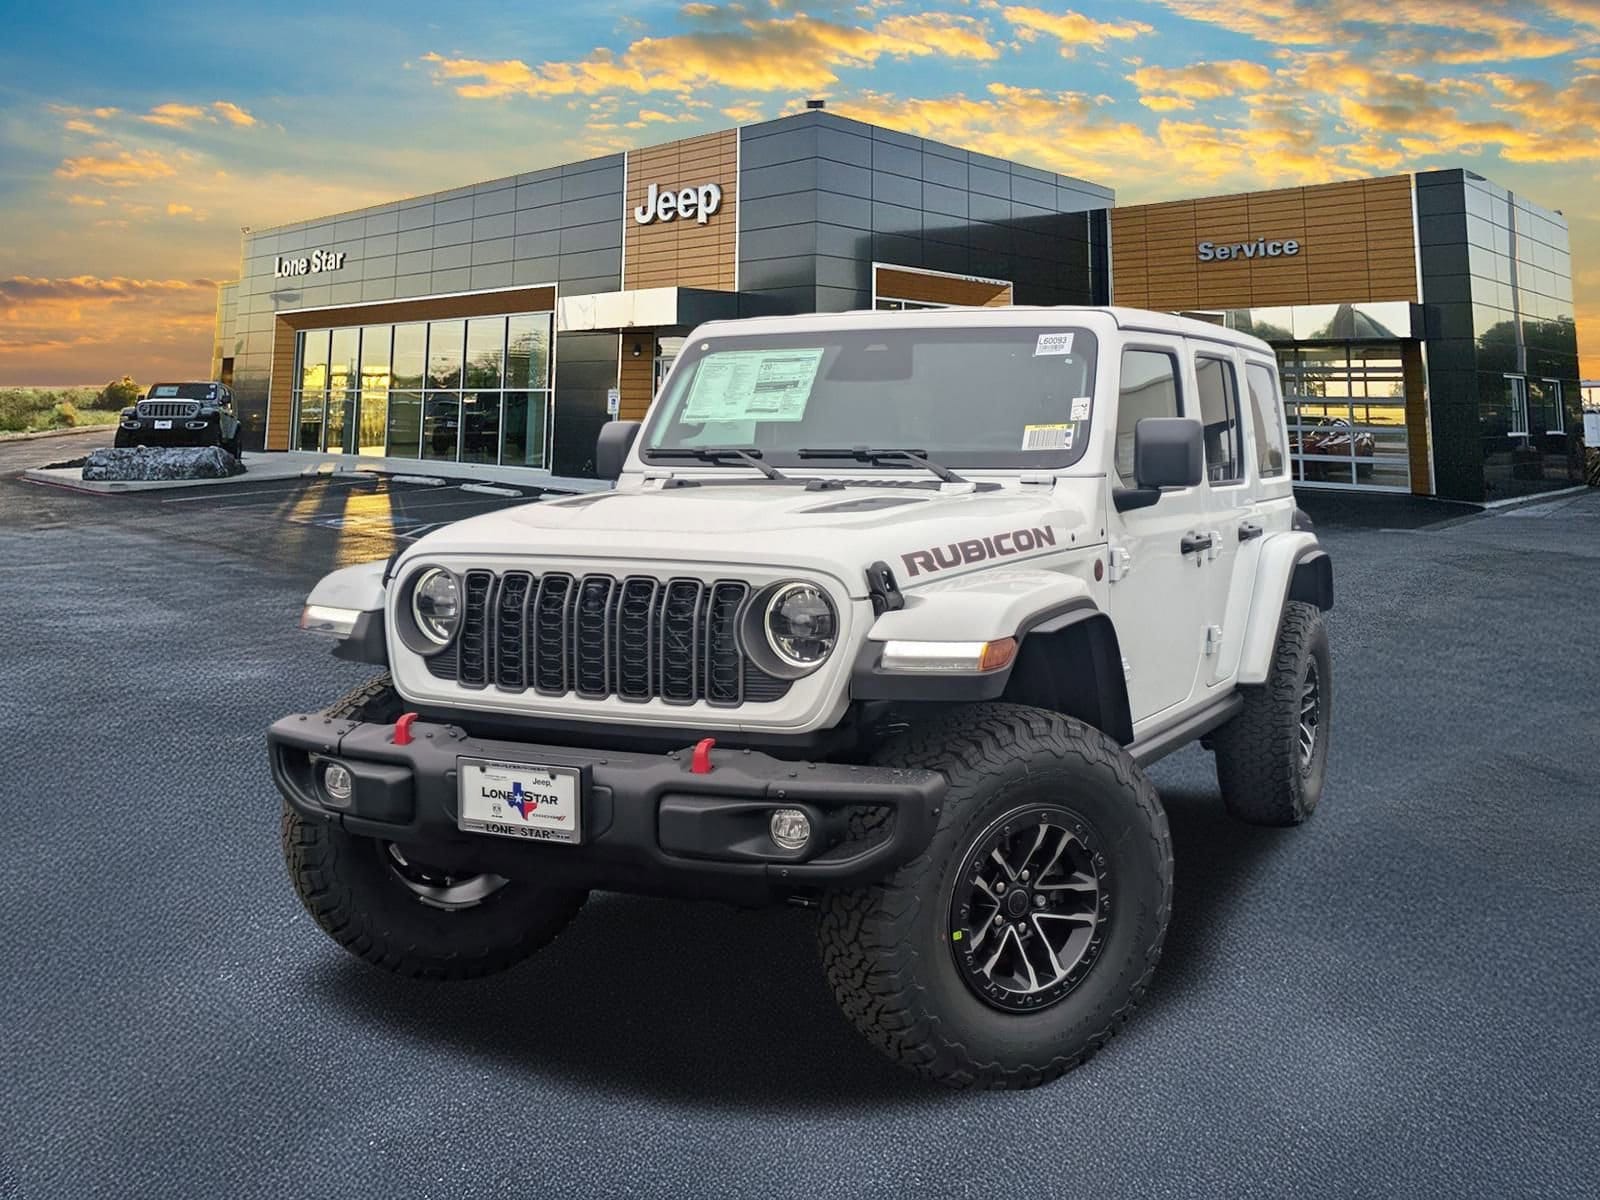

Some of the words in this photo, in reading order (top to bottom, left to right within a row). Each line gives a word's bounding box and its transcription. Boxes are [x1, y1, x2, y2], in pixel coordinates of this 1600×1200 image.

[635, 183, 722, 225] Jeep
[1198, 236, 1299, 261] Service
[275, 257, 309, 277] Lone
[312, 250, 345, 272] Star
[900, 525, 1056, 576] RUBICON
[532, 778, 551, 787] Jeep
[482, 787, 514, 800] LONE
[523, 791, 558, 805] STAR
[486, 824, 516, 835] LONE
[520, 828, 551, 839] STAR
